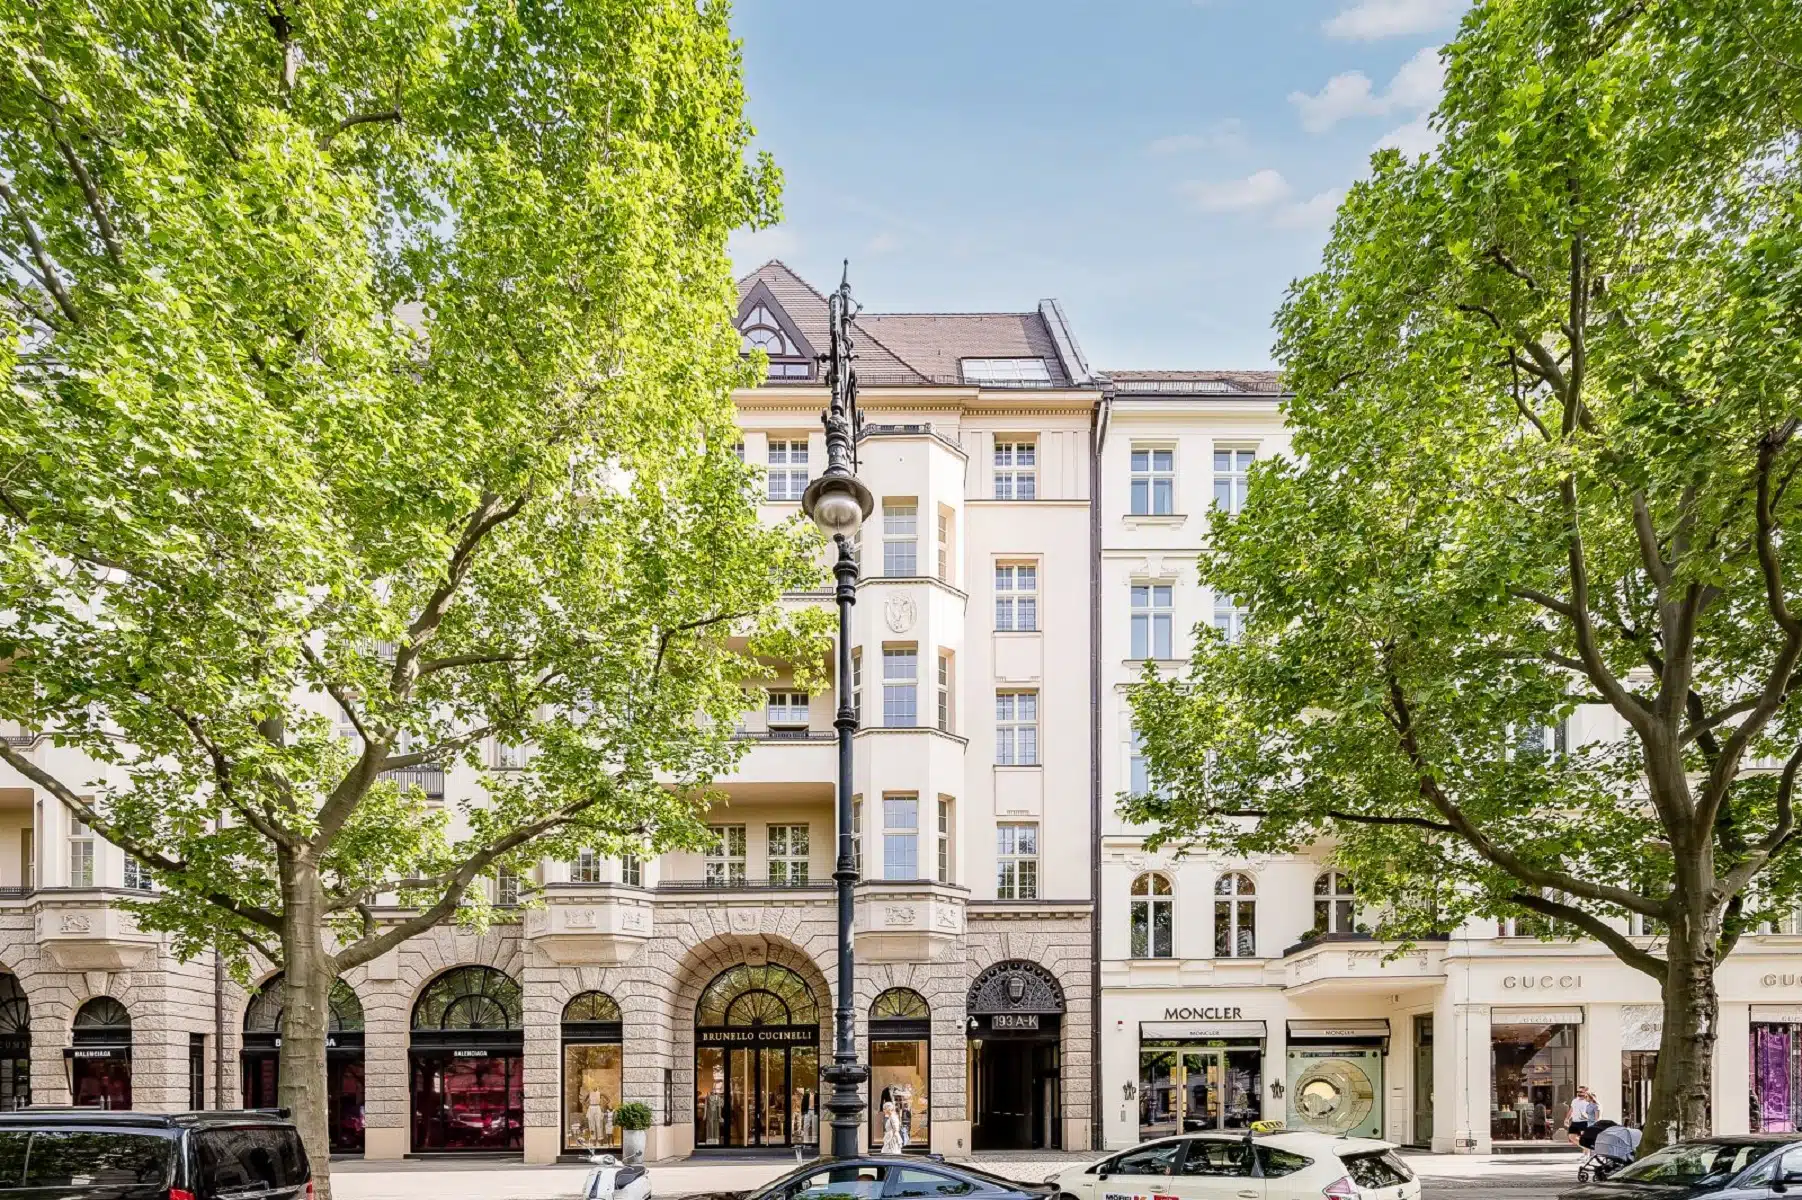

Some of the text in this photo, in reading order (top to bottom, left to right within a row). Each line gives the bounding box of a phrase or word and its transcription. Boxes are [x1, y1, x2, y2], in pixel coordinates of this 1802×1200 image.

[1503, 975, 1582, 989] GUCCI
[1763, 974, 1802, 987] GU
[1164, 1007, 1242, 1020] MONCLER
[993, 1015, 1037, 1027] 193 A-K
[703, 1031, 812, 1041] BRUNELLO CUCINELLI
